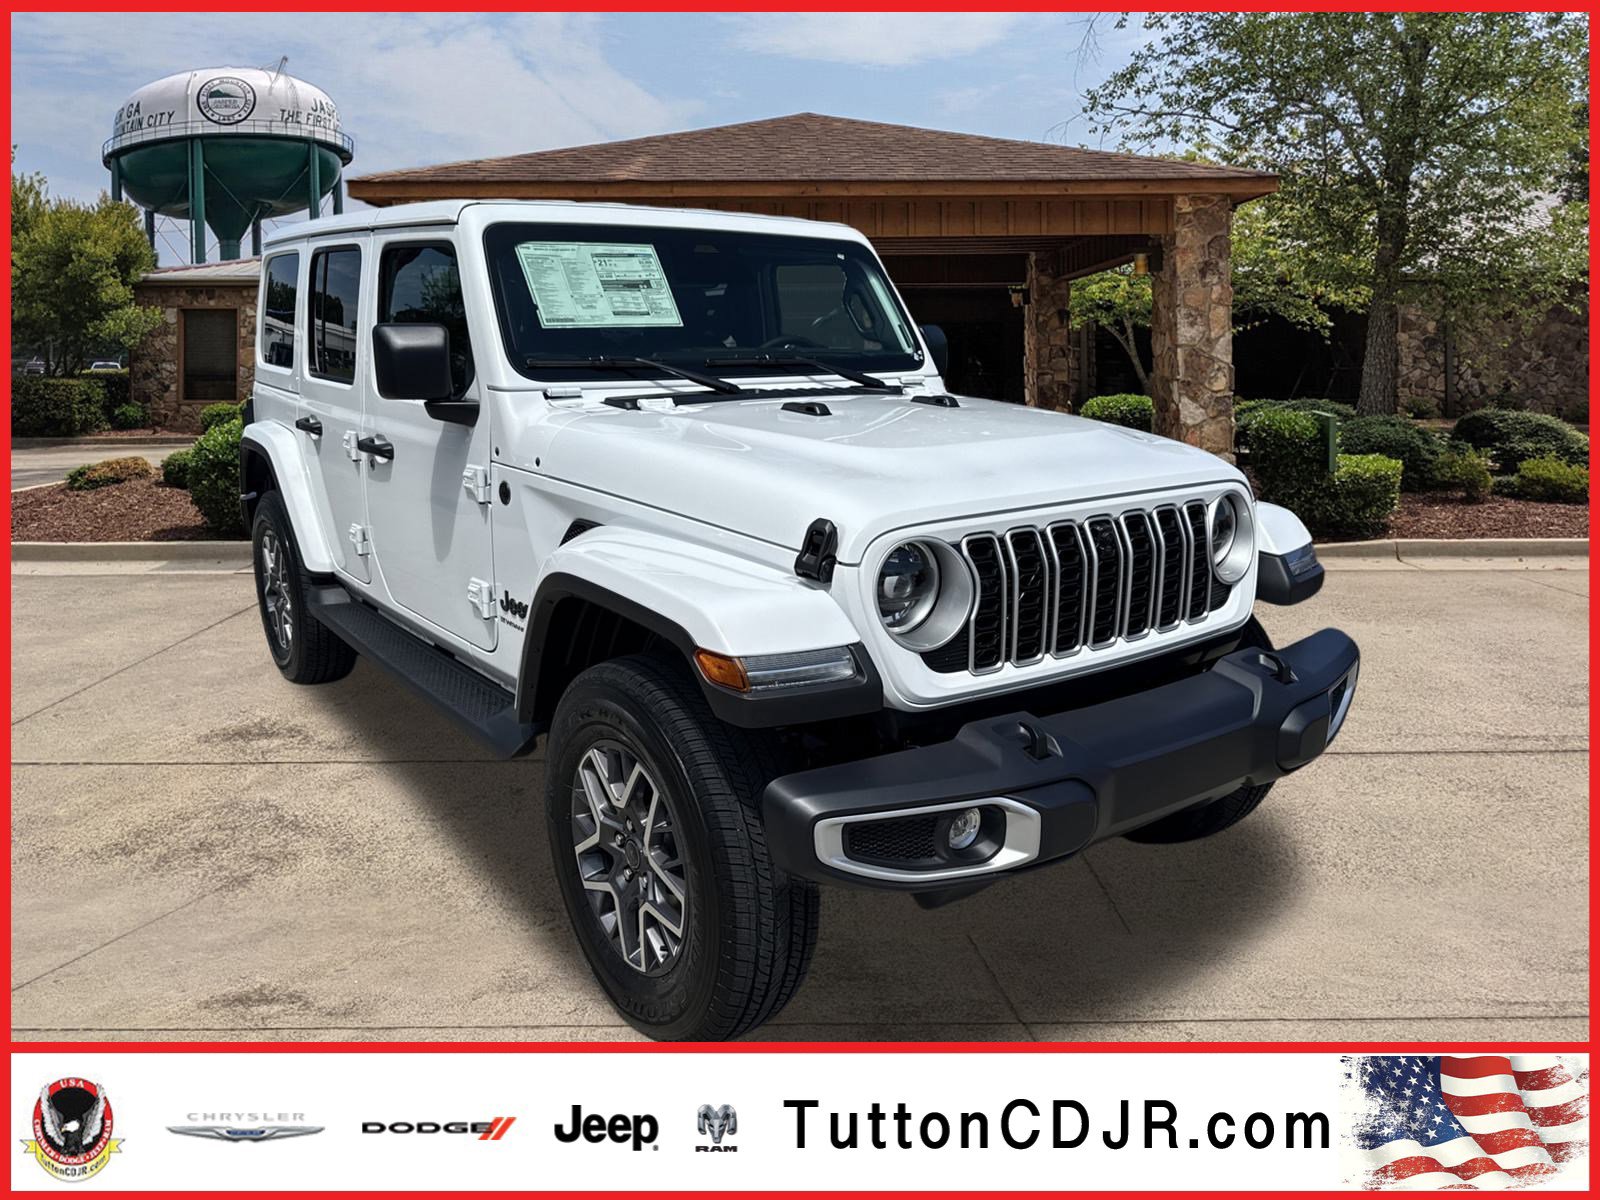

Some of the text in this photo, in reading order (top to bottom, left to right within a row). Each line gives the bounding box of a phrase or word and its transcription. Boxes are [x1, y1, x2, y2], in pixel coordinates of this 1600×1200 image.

[126, 101, 141, 119] GA
[147, 110, 175, 127] CITY
[280, 109, 302, 124] THE
